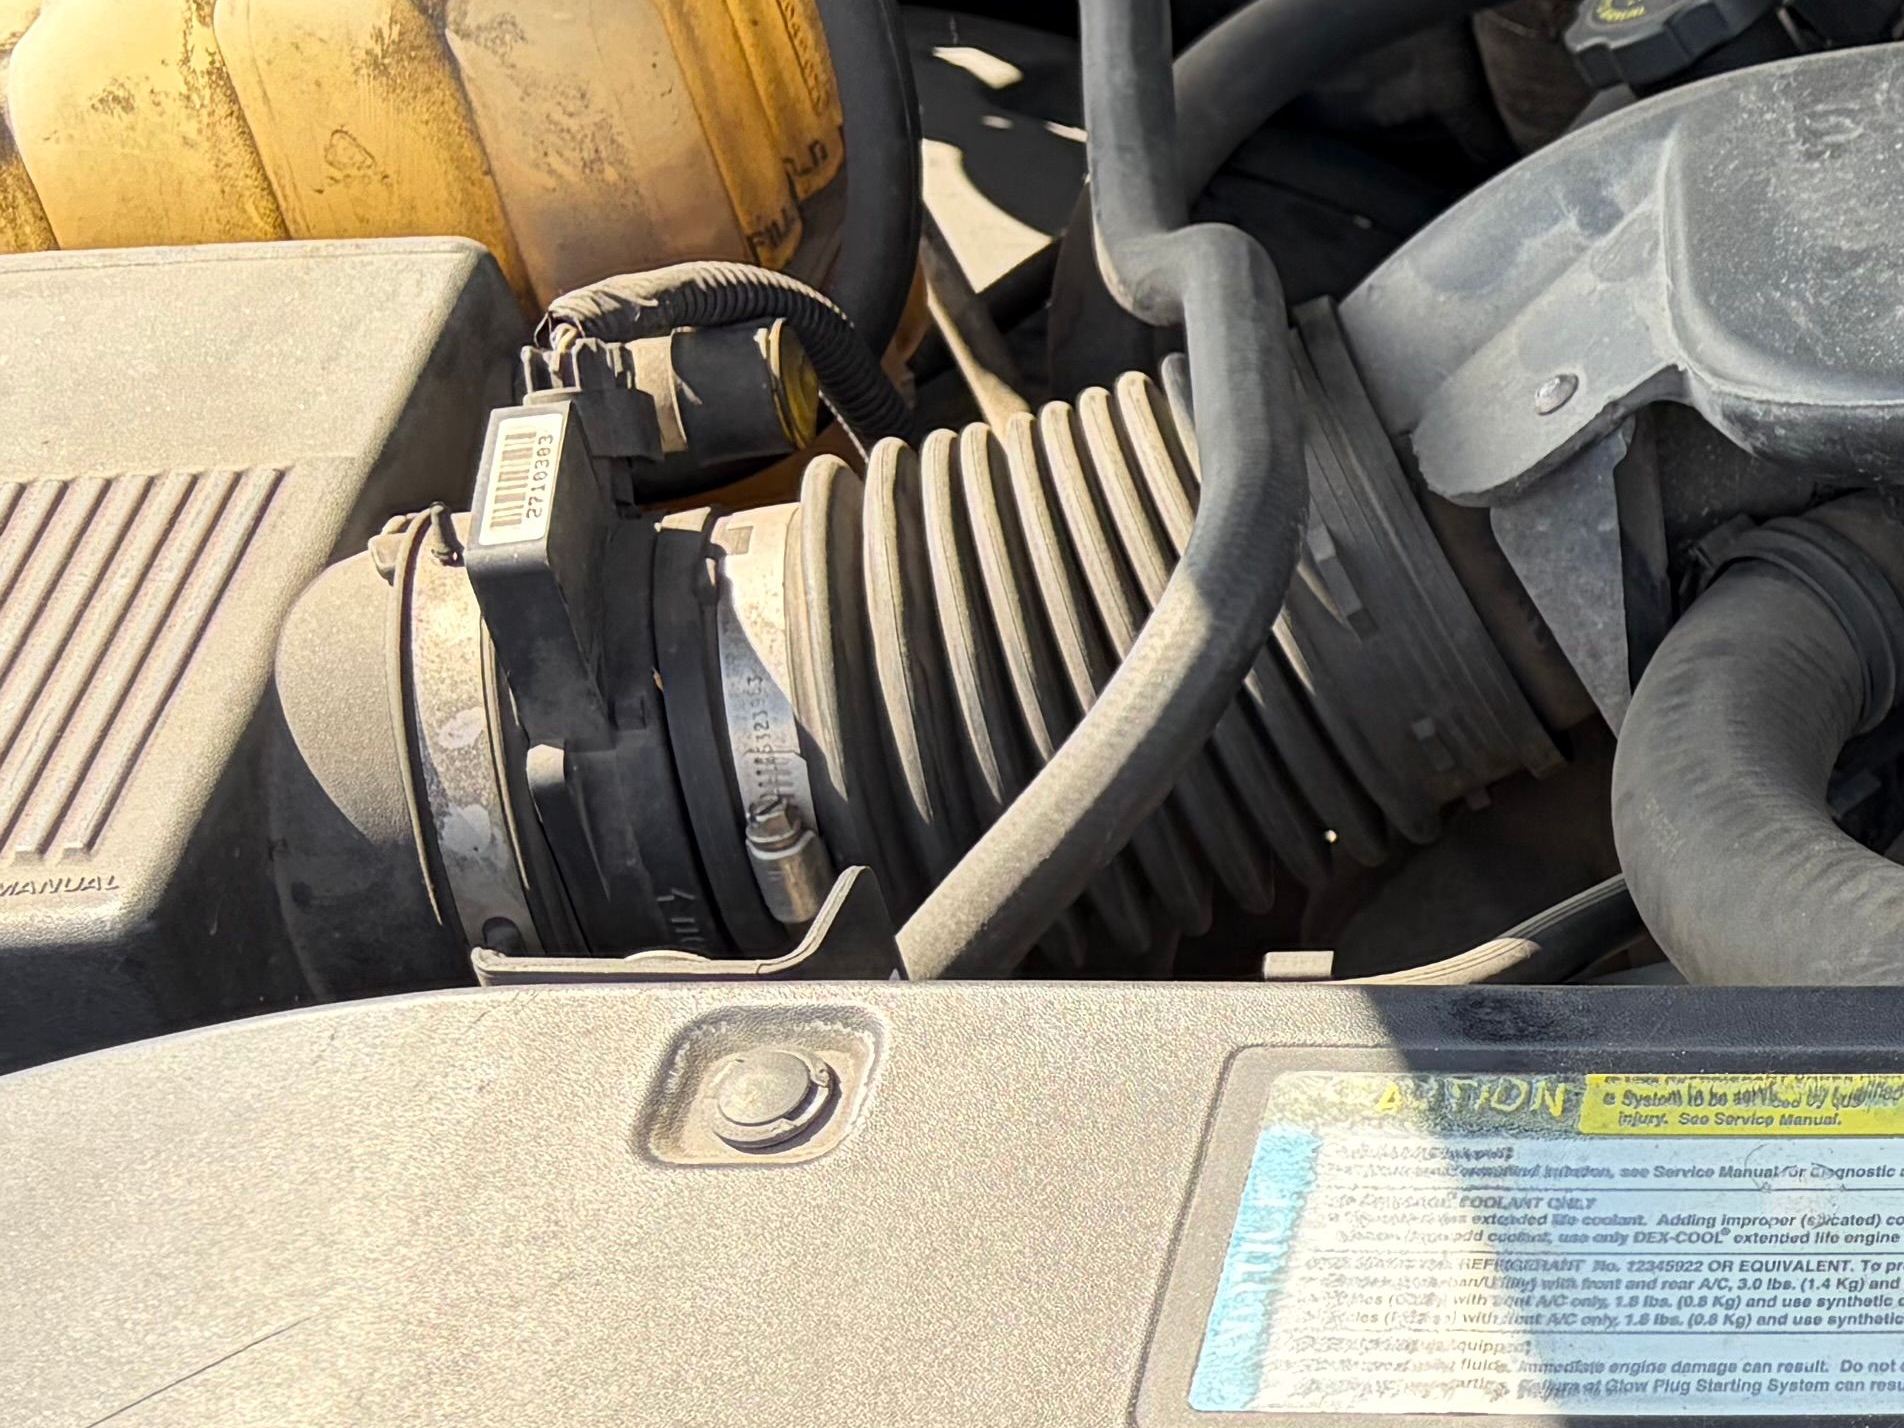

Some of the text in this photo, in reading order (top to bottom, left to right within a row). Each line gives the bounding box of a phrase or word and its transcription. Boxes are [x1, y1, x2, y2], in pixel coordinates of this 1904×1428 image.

[1678, 1112, 1710, 1126] See
[1714, 1112, 1774, 1127] Service
[1779, 1112, 1842, 1127] Manual.
[1653, 1165, 1716, 1179] Service
[1719, 1165, 1778, 1179] Manual
[1472, 1212, 1548, 1226] extended
[1582, 1212, 1648, 1227] coolant.
[1656, 1213, 1716, 1230] Adding
[1721, 1213, 1795, 1230] improper
[1558, 1231, 1588, 1244] use
[1592, 1230, 1629, 1247] only
[1733, 1230, 1810, 1244] extended
[1814, 1230, 1840, 1244] life
[1843, 1230, 1900, 1247] engine
[1592, 1259, 1621, 1272] No.
[1707, 1260, 1734, 1273] OR
[1738, 1259, 1855, 1274] EQUIVALENT.
[1861, 1259, 1882, 1273] To
[1541, 1276, 1578, 1291] with
[1625, 1277, 1657, 1291] and
[1661, 1278, 1694, 1291] rear
[1698, 1277, 1733, 1293] A/C,
[1737, 1277, 1763, 1292] 3.0
[1767, 1277, 1796, 1291] lbs.
[1800, 1277, 1831, 1293] (1.4
[1835, 1277, 1865, 1294] Kg)
[1869, 1277, 1900, 1291] and
[1535, 1294, 1568, 1308] A/C
[1571, 1294, 1611, 1310] only,
[1643, 1295, 1673, 1309] lbs.
[1712, 1295, 1742, 1311] Kg)
[1746, 1295, 1777, 1308] and
[1781, 1296, 1812, 1309] use
[1816, 1294, 1894, 1311] synthetic
[1547, 1312, 1578, 1326] A/C
[1581, 1312, 1621, 1329] only,
[1654, 1313, 1683, 1327] lbs.
[1722, 1312, 1752, 1329] Kg)
[1756, 1312, 1788, 1326] and
[1792, 1314, 1822, 1327] use
[1827, 1312, 1904, 1329] synthetic
[1609, 1360, 1667, 1377] engine
[1670, 1360, 1738, 1376] damage
[1744, 1361, 1773, 1374] can
[1777, 1359, 1830, 1373] result.
[1840, 1359, 1865, 1373] Do
[1869, 1359, 1897, 1372] not
[1604, 1378, 1648, 1394] Glow
[1653, 1379, 1690, 1395] Plug
[1695, 1378, 1761, 1395] Starting
[1766, 1378, 1829, 1395] System
[1834, 1379, 1865, 1393] can
